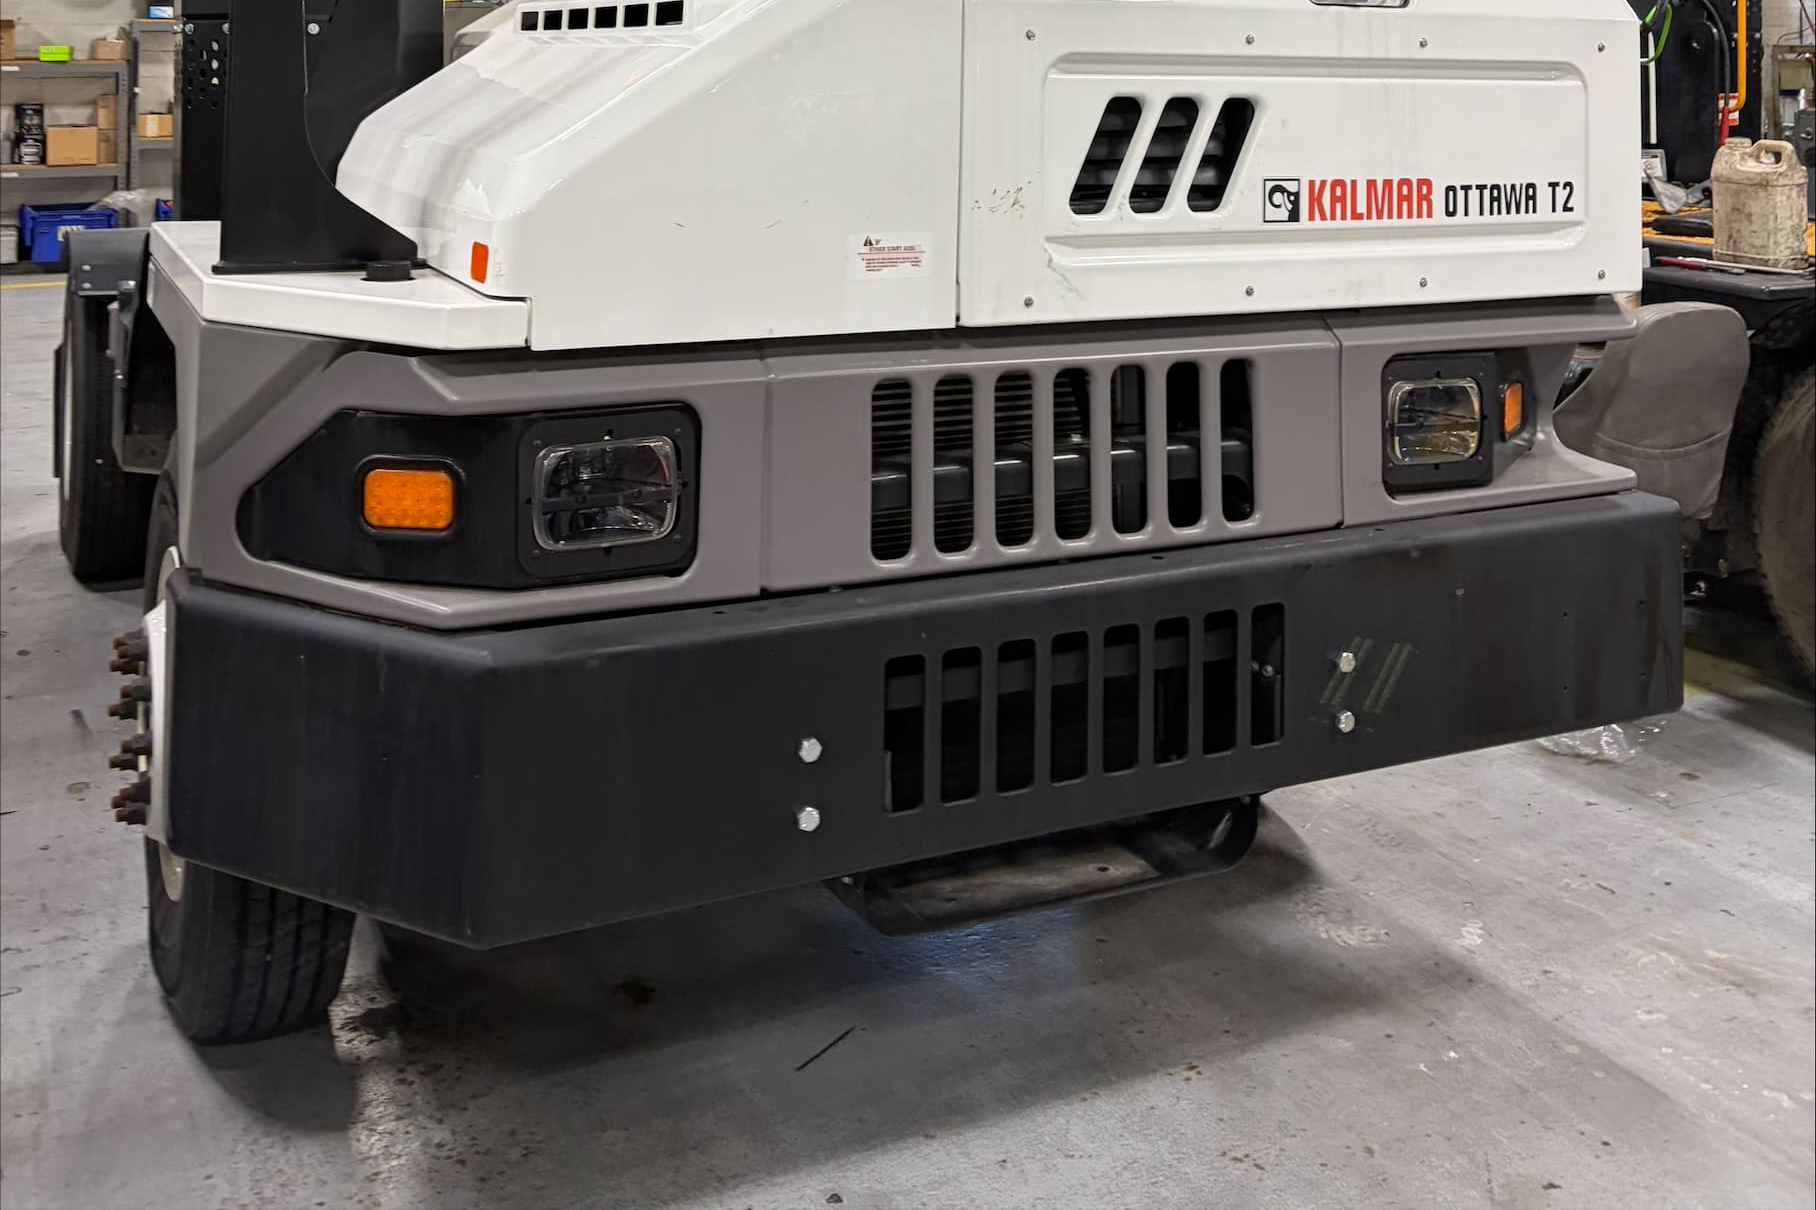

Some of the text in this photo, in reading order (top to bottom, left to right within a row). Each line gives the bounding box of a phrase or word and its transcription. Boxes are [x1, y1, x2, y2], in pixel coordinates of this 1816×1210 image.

[1307, 177, 1575, 222] KALMAR OTTAWA T2
